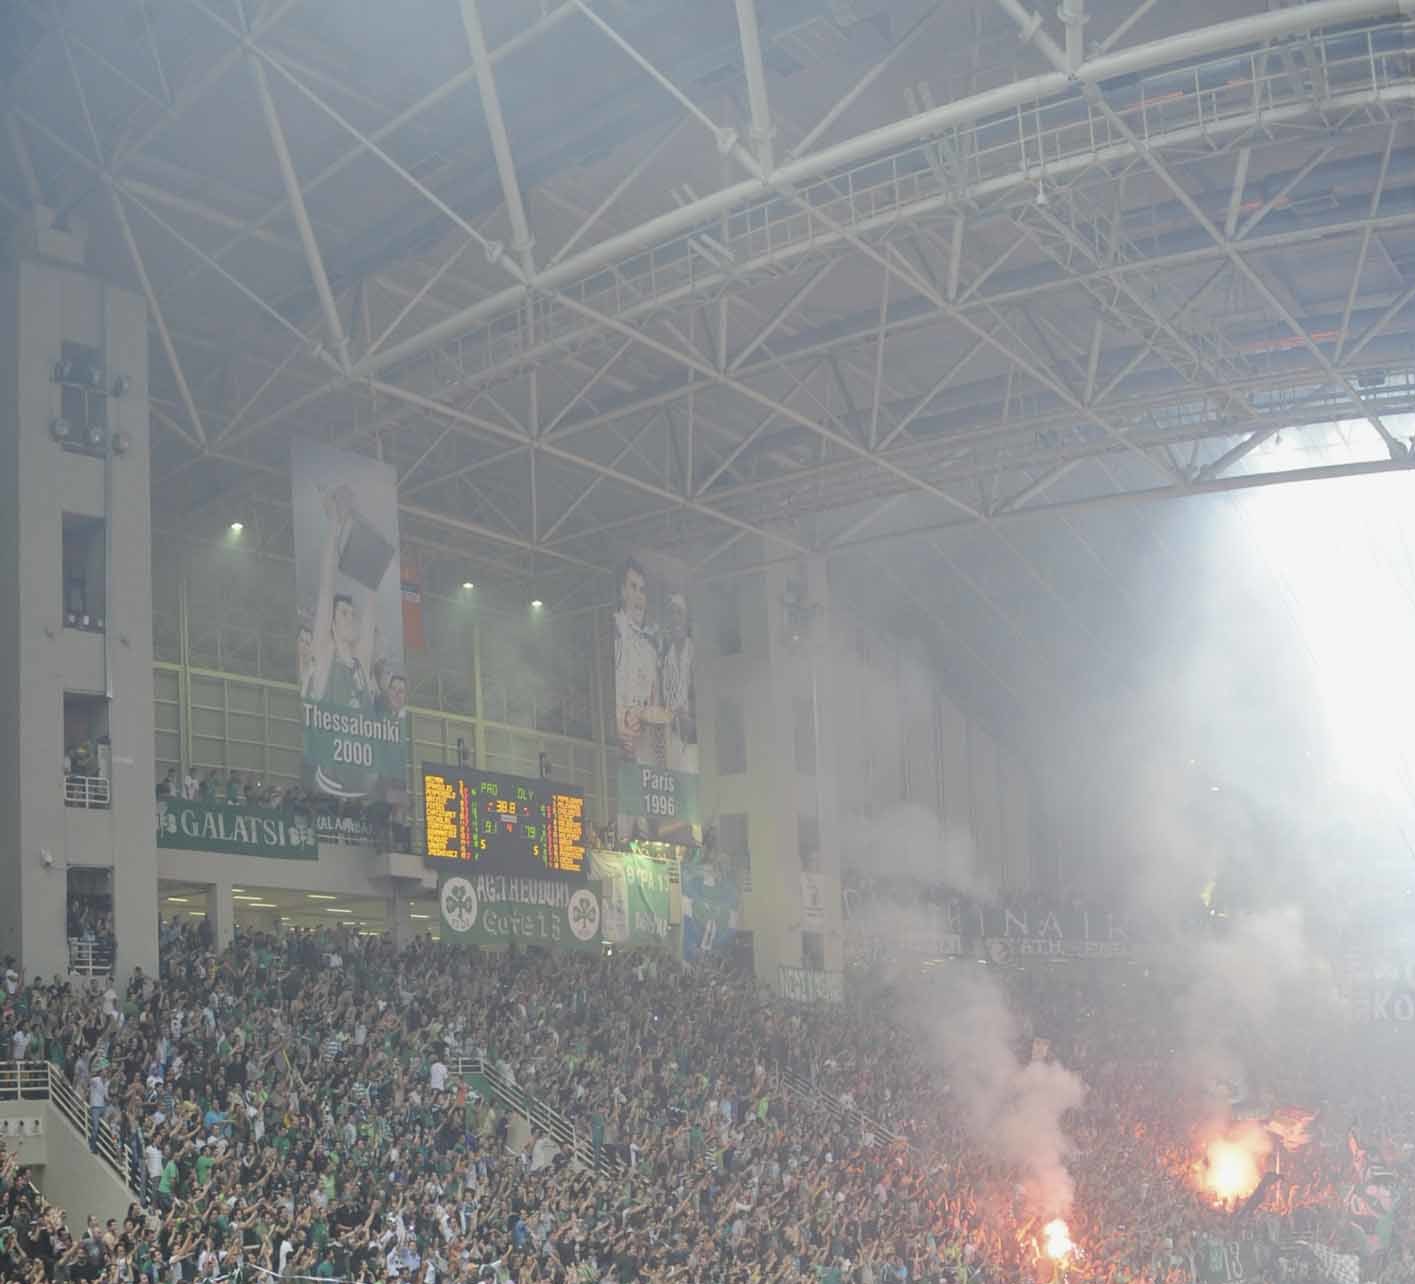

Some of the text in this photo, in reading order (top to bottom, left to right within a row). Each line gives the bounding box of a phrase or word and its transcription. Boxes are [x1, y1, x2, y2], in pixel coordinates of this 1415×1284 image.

[303, 703, 400, 744] Thessaloniki
[333, 739, 373, 767] 2000
[642, 768, 675, 793] Paris
[644, 795, 675, 816] 1996
[180, 807, 284, 847] GALATSI
